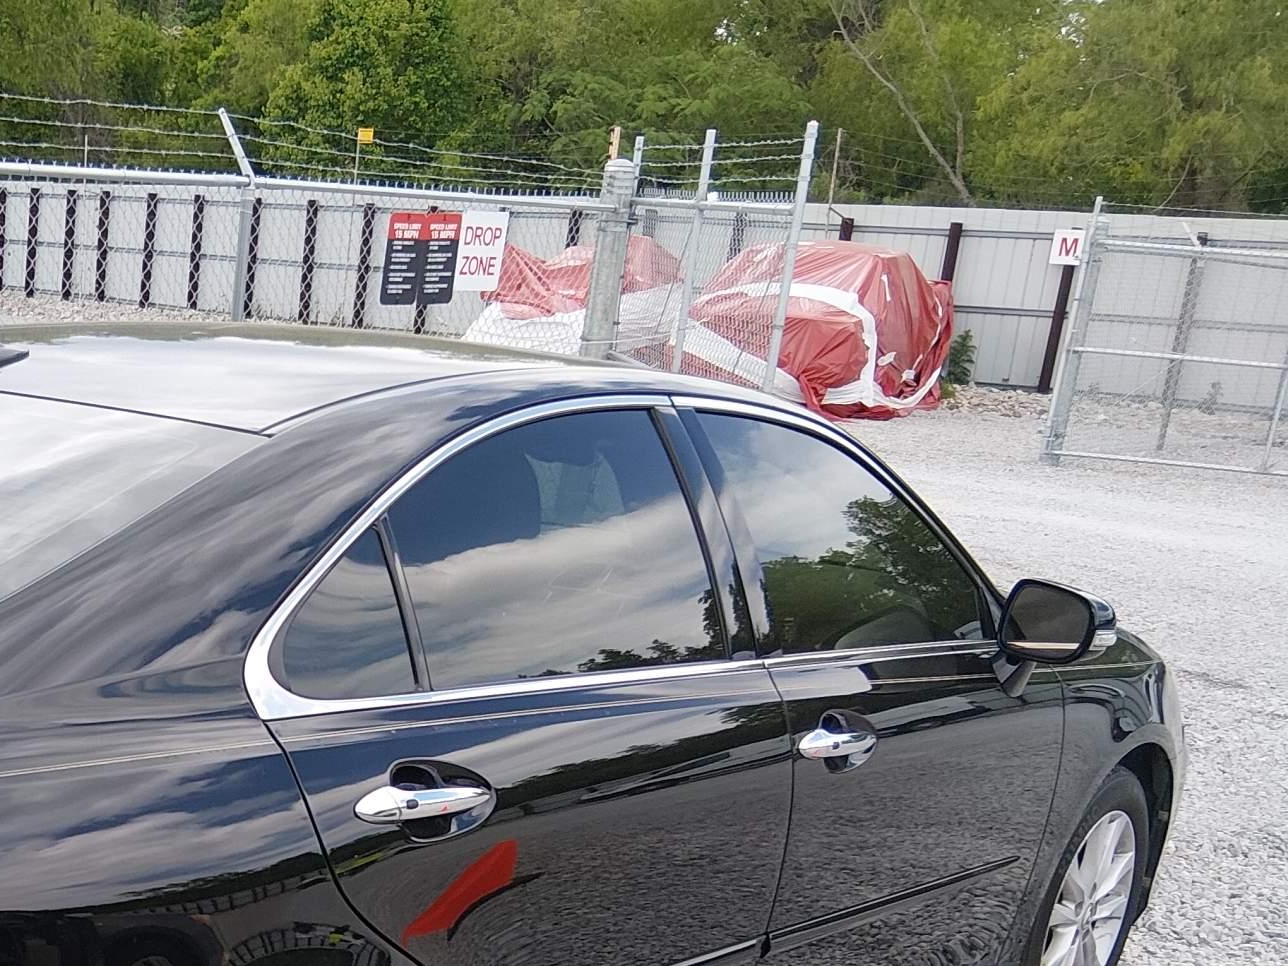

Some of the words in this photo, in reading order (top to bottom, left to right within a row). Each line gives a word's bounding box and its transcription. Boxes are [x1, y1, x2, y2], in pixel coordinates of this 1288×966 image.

[464, 226, 502, 247] DROP
[1058, 237, 1080, 257] M
[460, 256, 497, 276] ZONE
